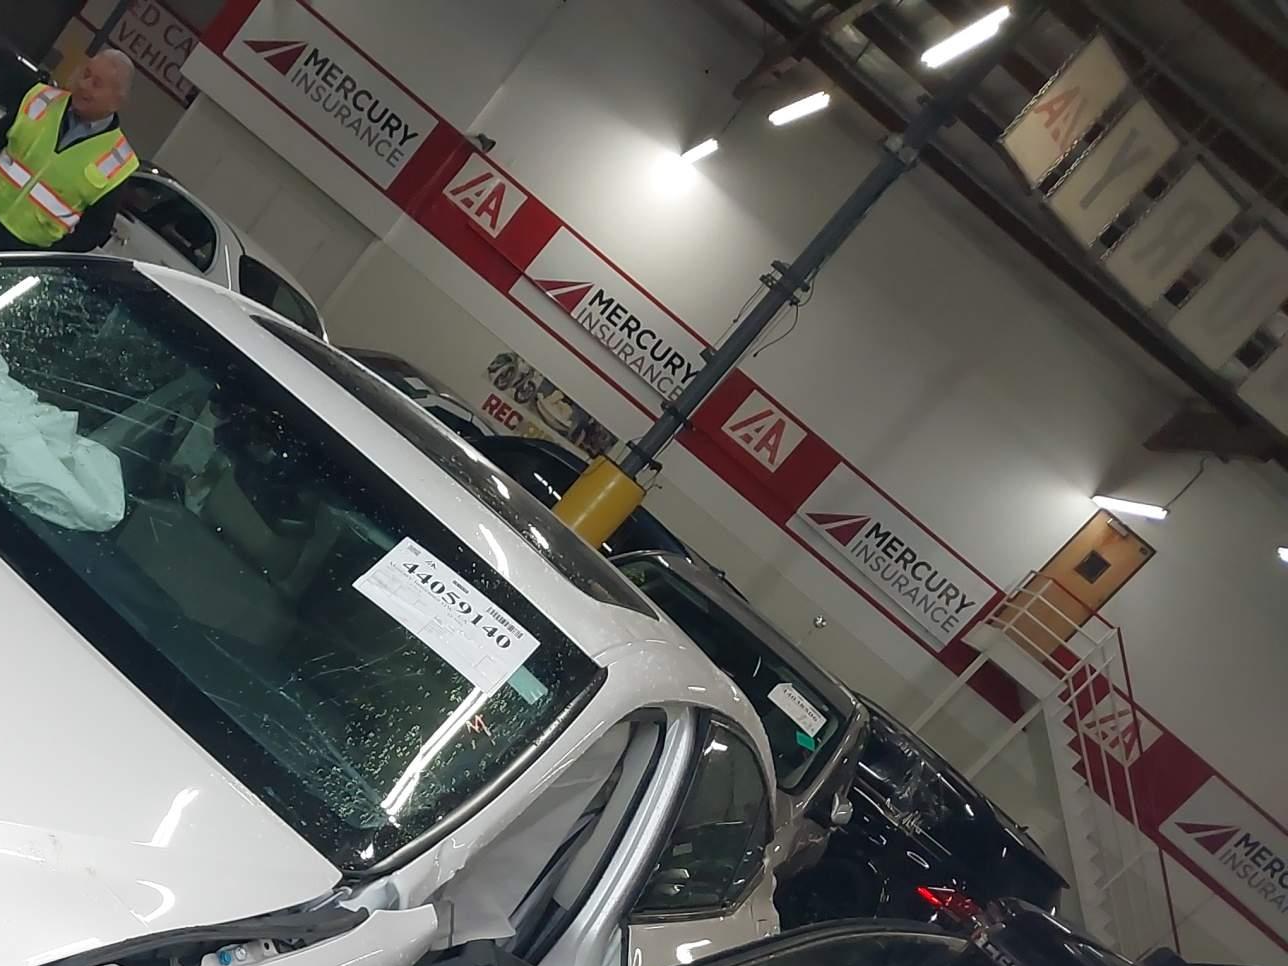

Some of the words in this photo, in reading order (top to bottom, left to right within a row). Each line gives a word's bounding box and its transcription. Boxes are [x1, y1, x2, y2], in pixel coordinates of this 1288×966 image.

[290, 68, 405, 168] INSURANCE
[303, 48, 419, 147] MERCURY
[576, 307, 684, 401] INSURANCE
[588, 288, 699, 384] MERCURY
[402, 560, 511, 649] 44059140
[850, 540, 960, 633] INSURANCE
[864, 521, 977, 615] MERCURY
